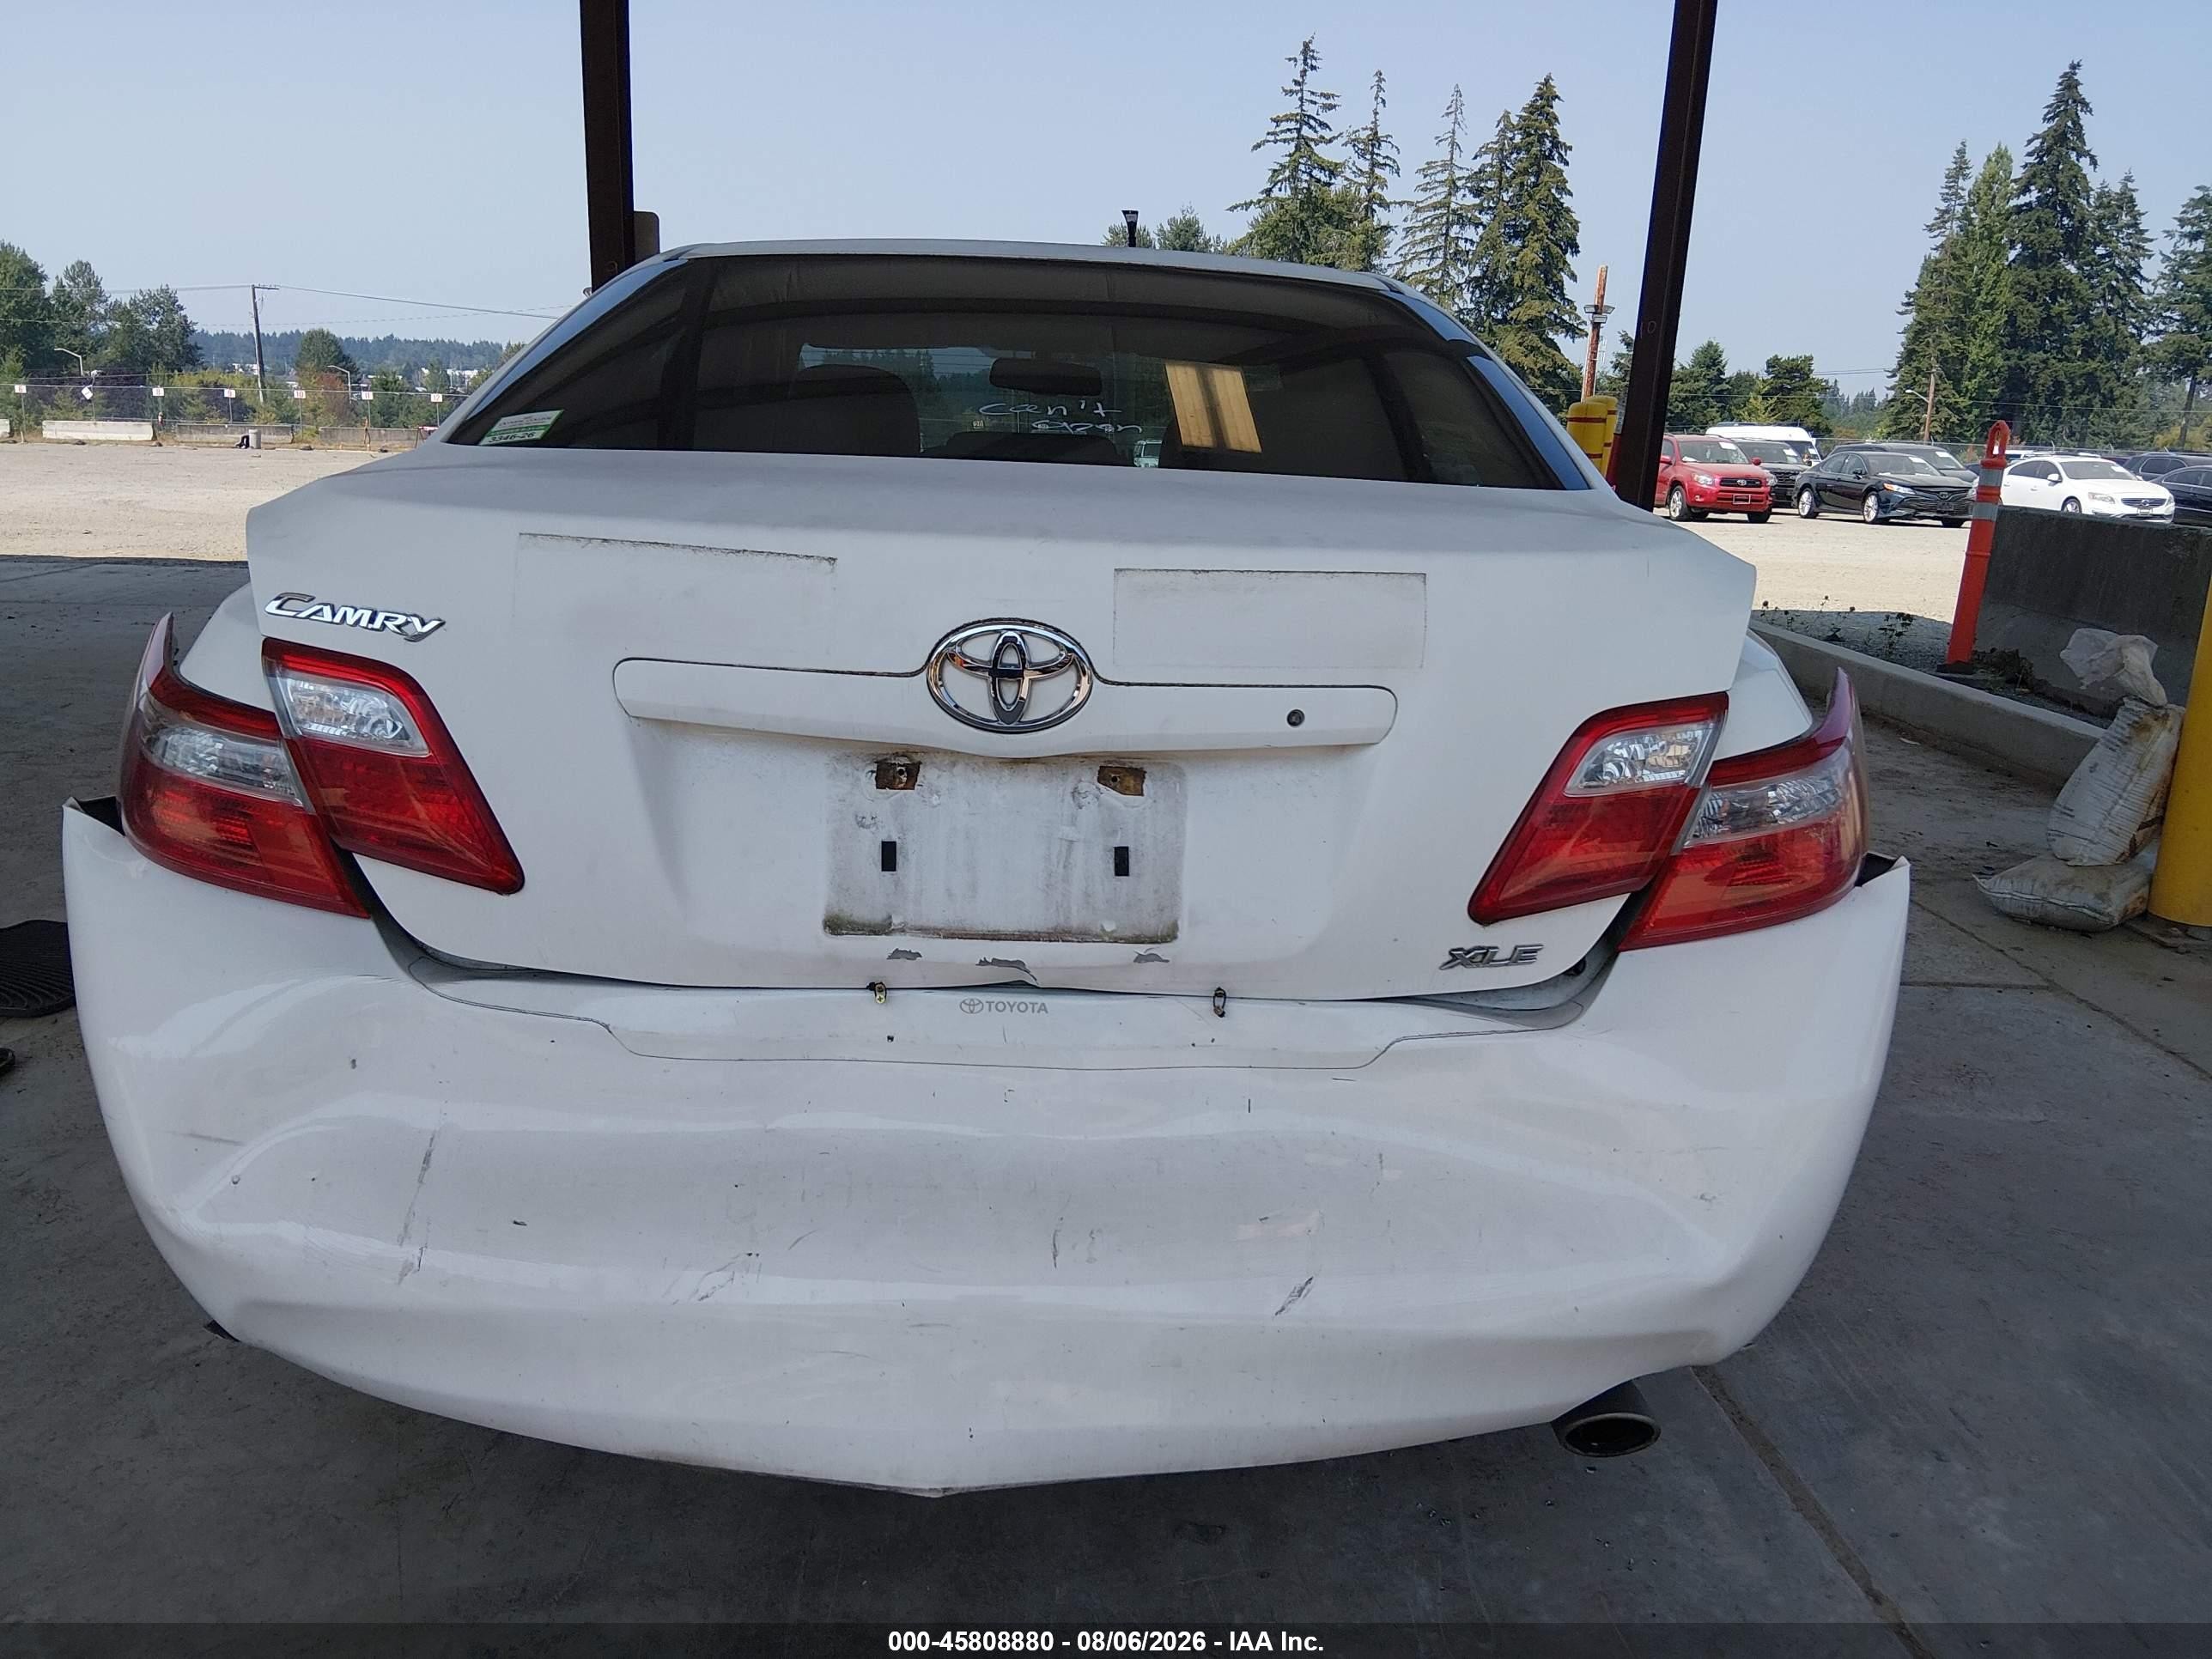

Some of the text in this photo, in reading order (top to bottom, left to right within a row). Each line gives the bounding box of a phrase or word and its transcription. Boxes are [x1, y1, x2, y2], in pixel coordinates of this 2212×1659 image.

[264, 592, 446, 642] CAMRY
[1439, 944, 1544, 970] XLE
[986, 1001, 1048, 1013] TOYOTA
